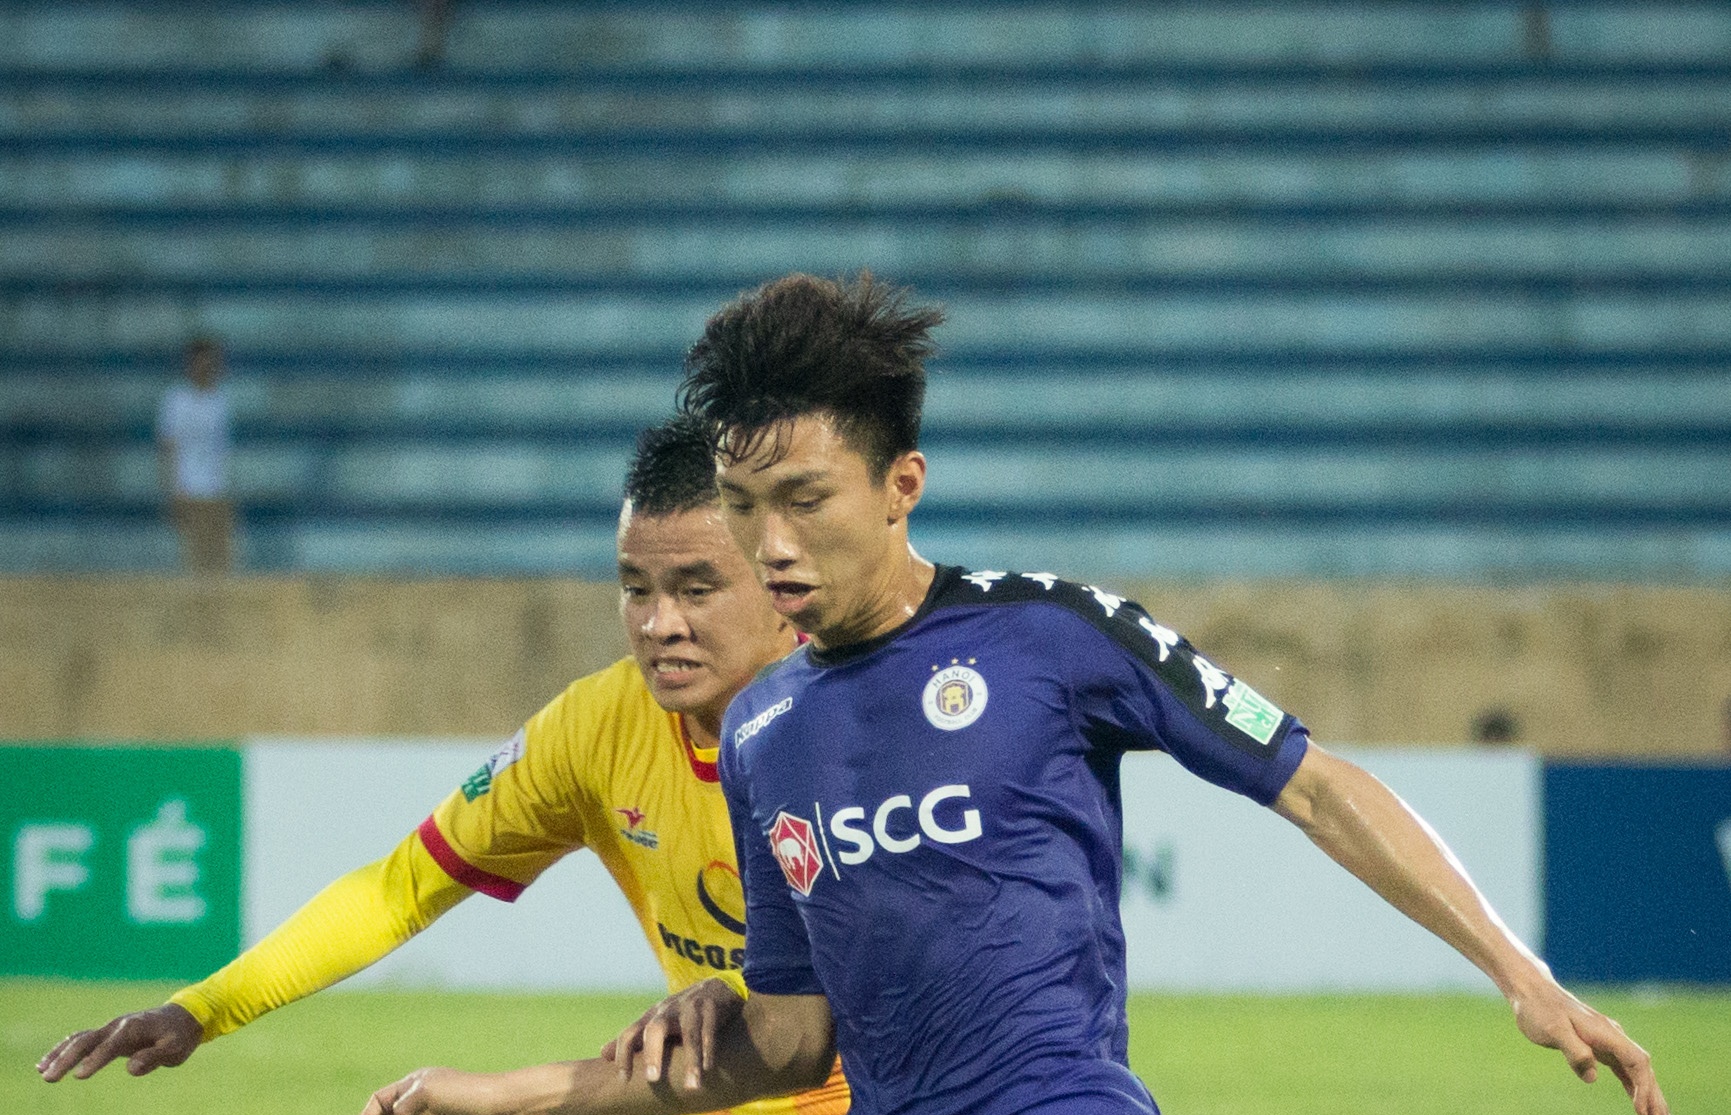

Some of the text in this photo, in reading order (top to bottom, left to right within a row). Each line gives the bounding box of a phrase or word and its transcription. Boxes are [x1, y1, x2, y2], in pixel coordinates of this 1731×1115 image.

[932, 669, 975, 688] HANOI
[14, 799, 207, 921] FÉ
[830, 784, 982, 865] SCG
